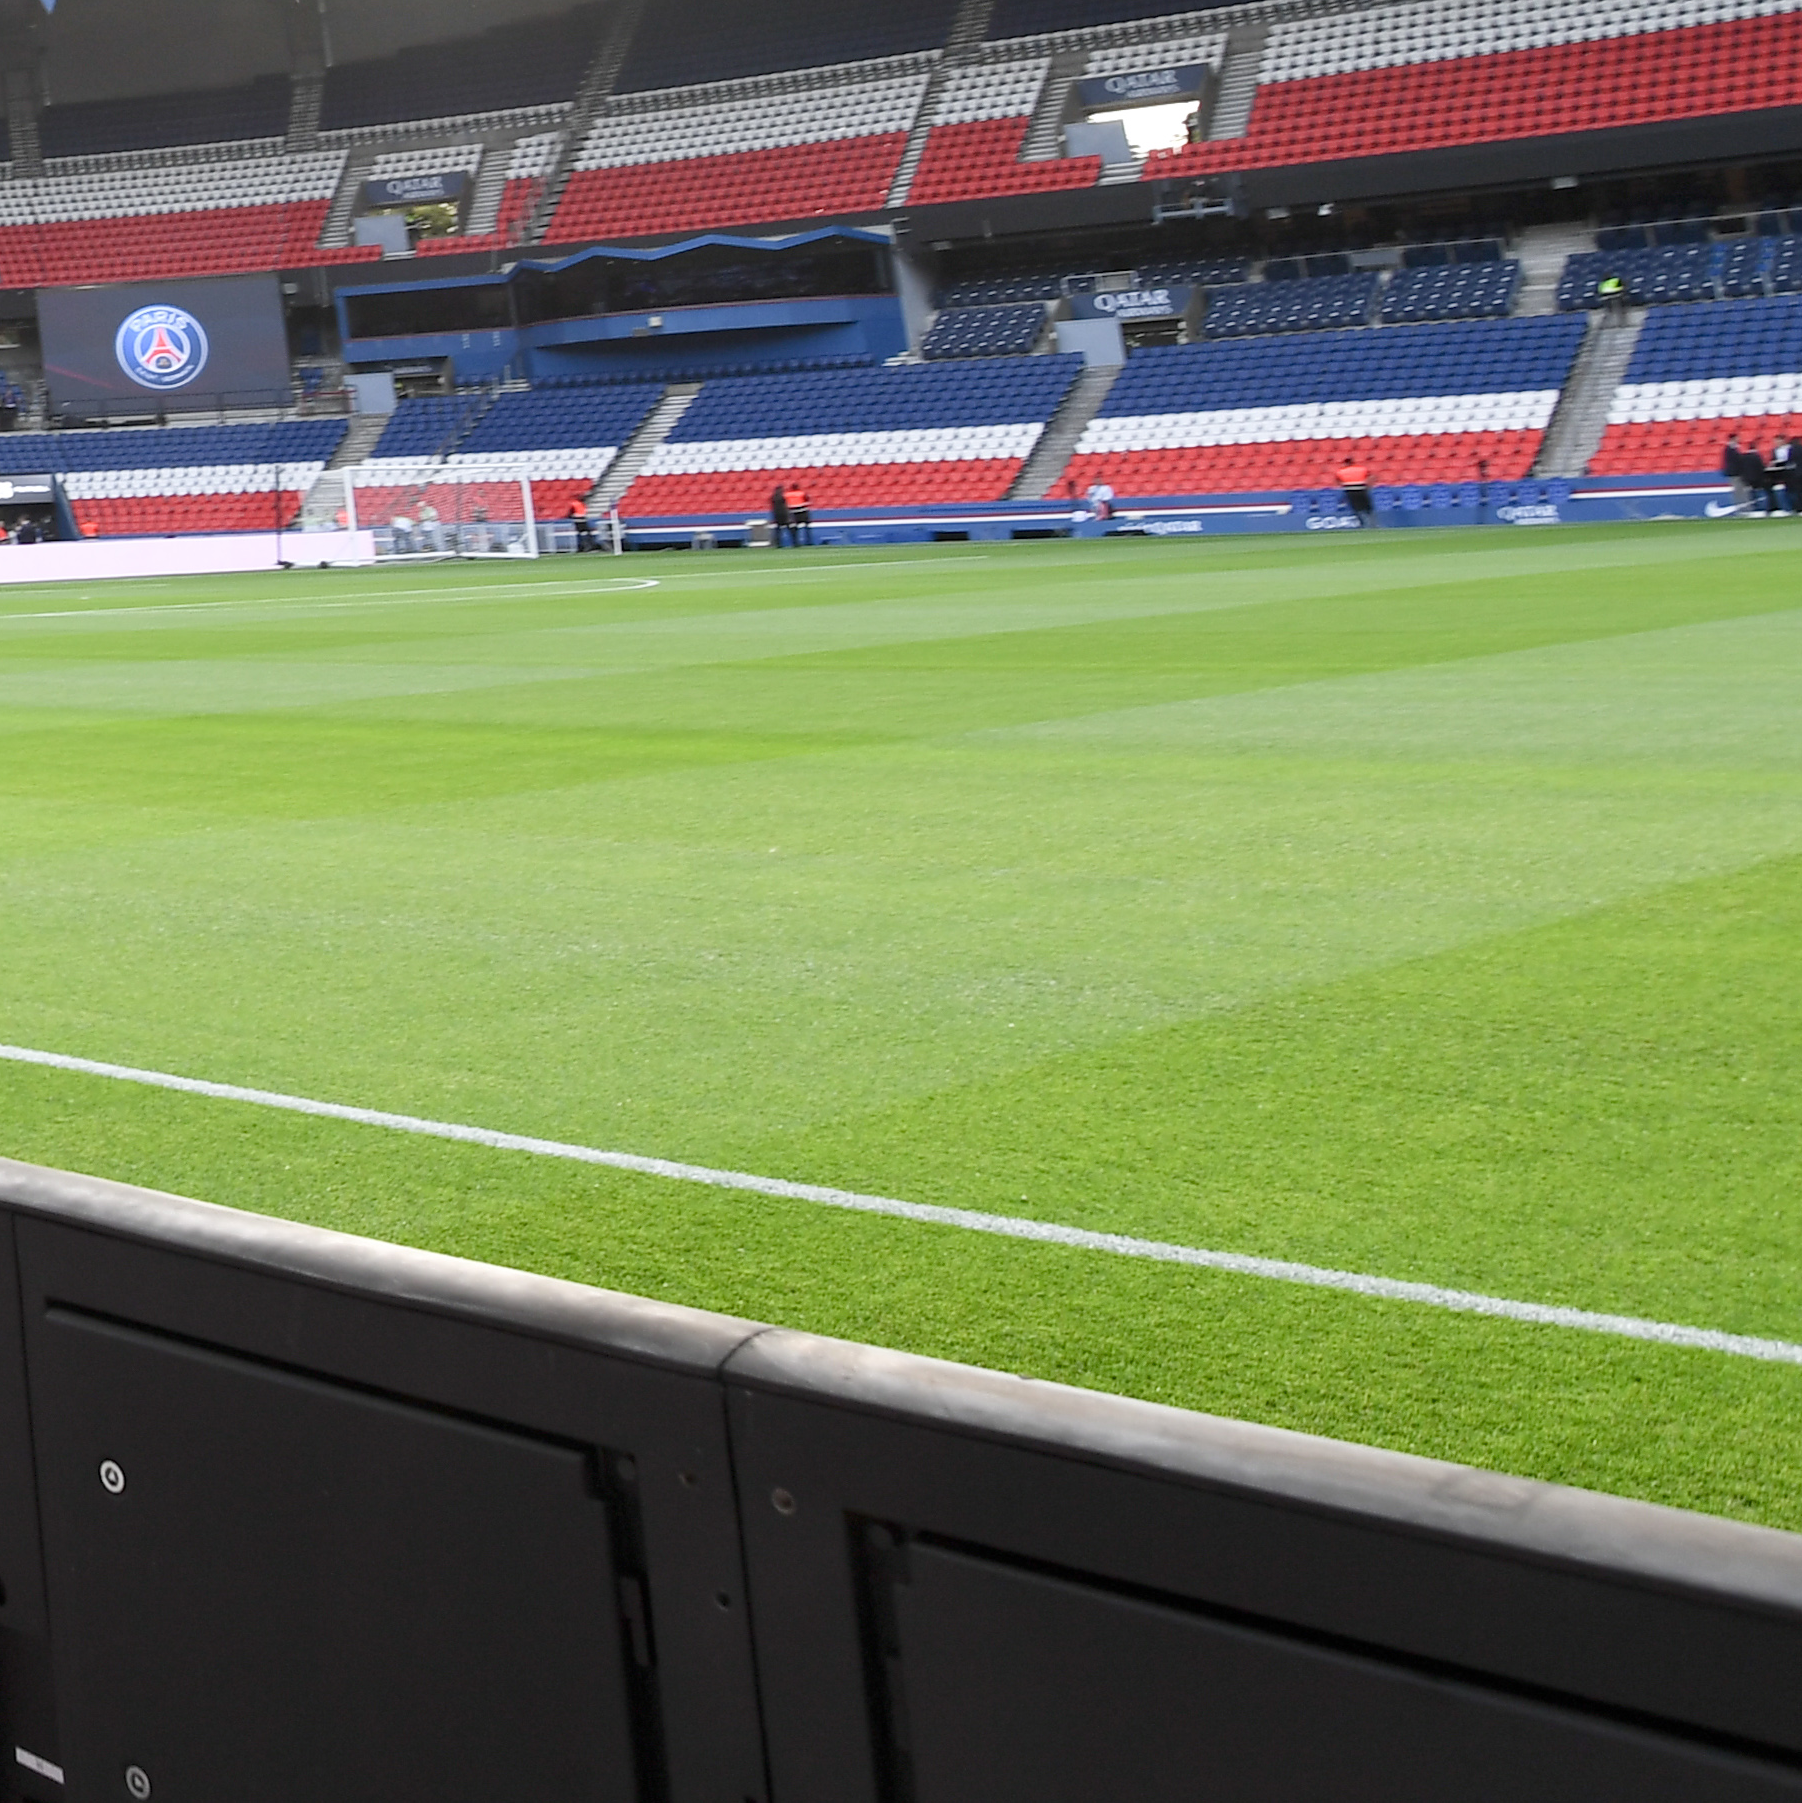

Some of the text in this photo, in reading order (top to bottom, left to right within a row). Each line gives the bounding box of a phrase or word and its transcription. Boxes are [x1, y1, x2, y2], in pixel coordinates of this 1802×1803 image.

[1105, 69, 1179, 93] QATAR
[386, 176, 443, 195] QATAR
[1093, 289, 1171, 313] QATAR
[129, 311, 189, 332] PARIS
[1496, 505, 1560, 522] QATAR
